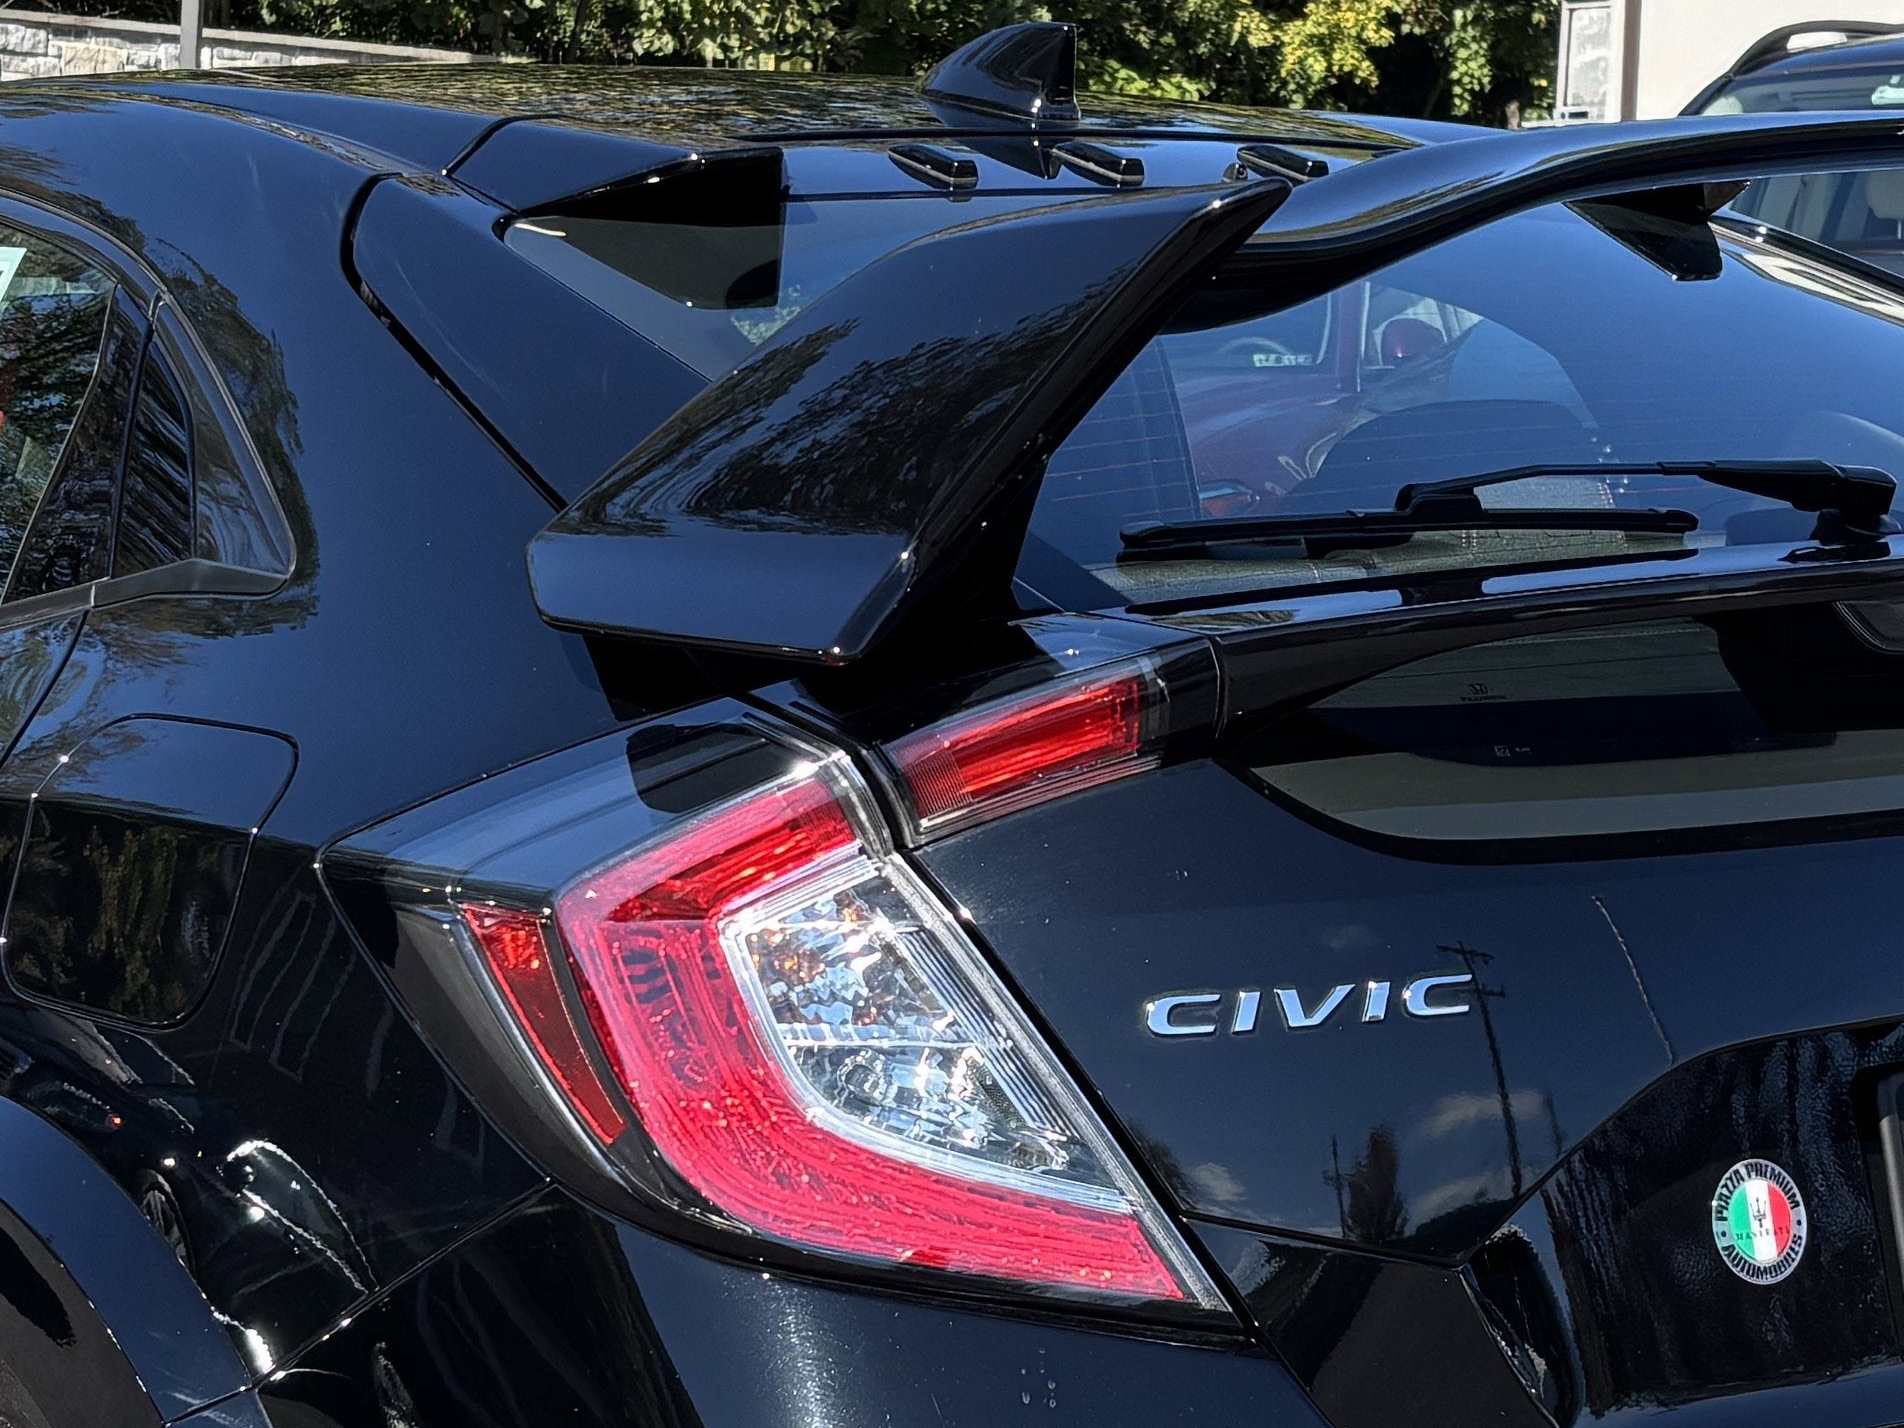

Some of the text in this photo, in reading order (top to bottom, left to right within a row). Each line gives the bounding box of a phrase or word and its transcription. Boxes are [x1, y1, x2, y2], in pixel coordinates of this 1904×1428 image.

[1146, 974, 1473, 1036] CIVIC
[1716, 1161, 1801, 1222] PIAZZA PREMIUM
[1721, 1233, 1803, 1280] AUTOMOBILES
